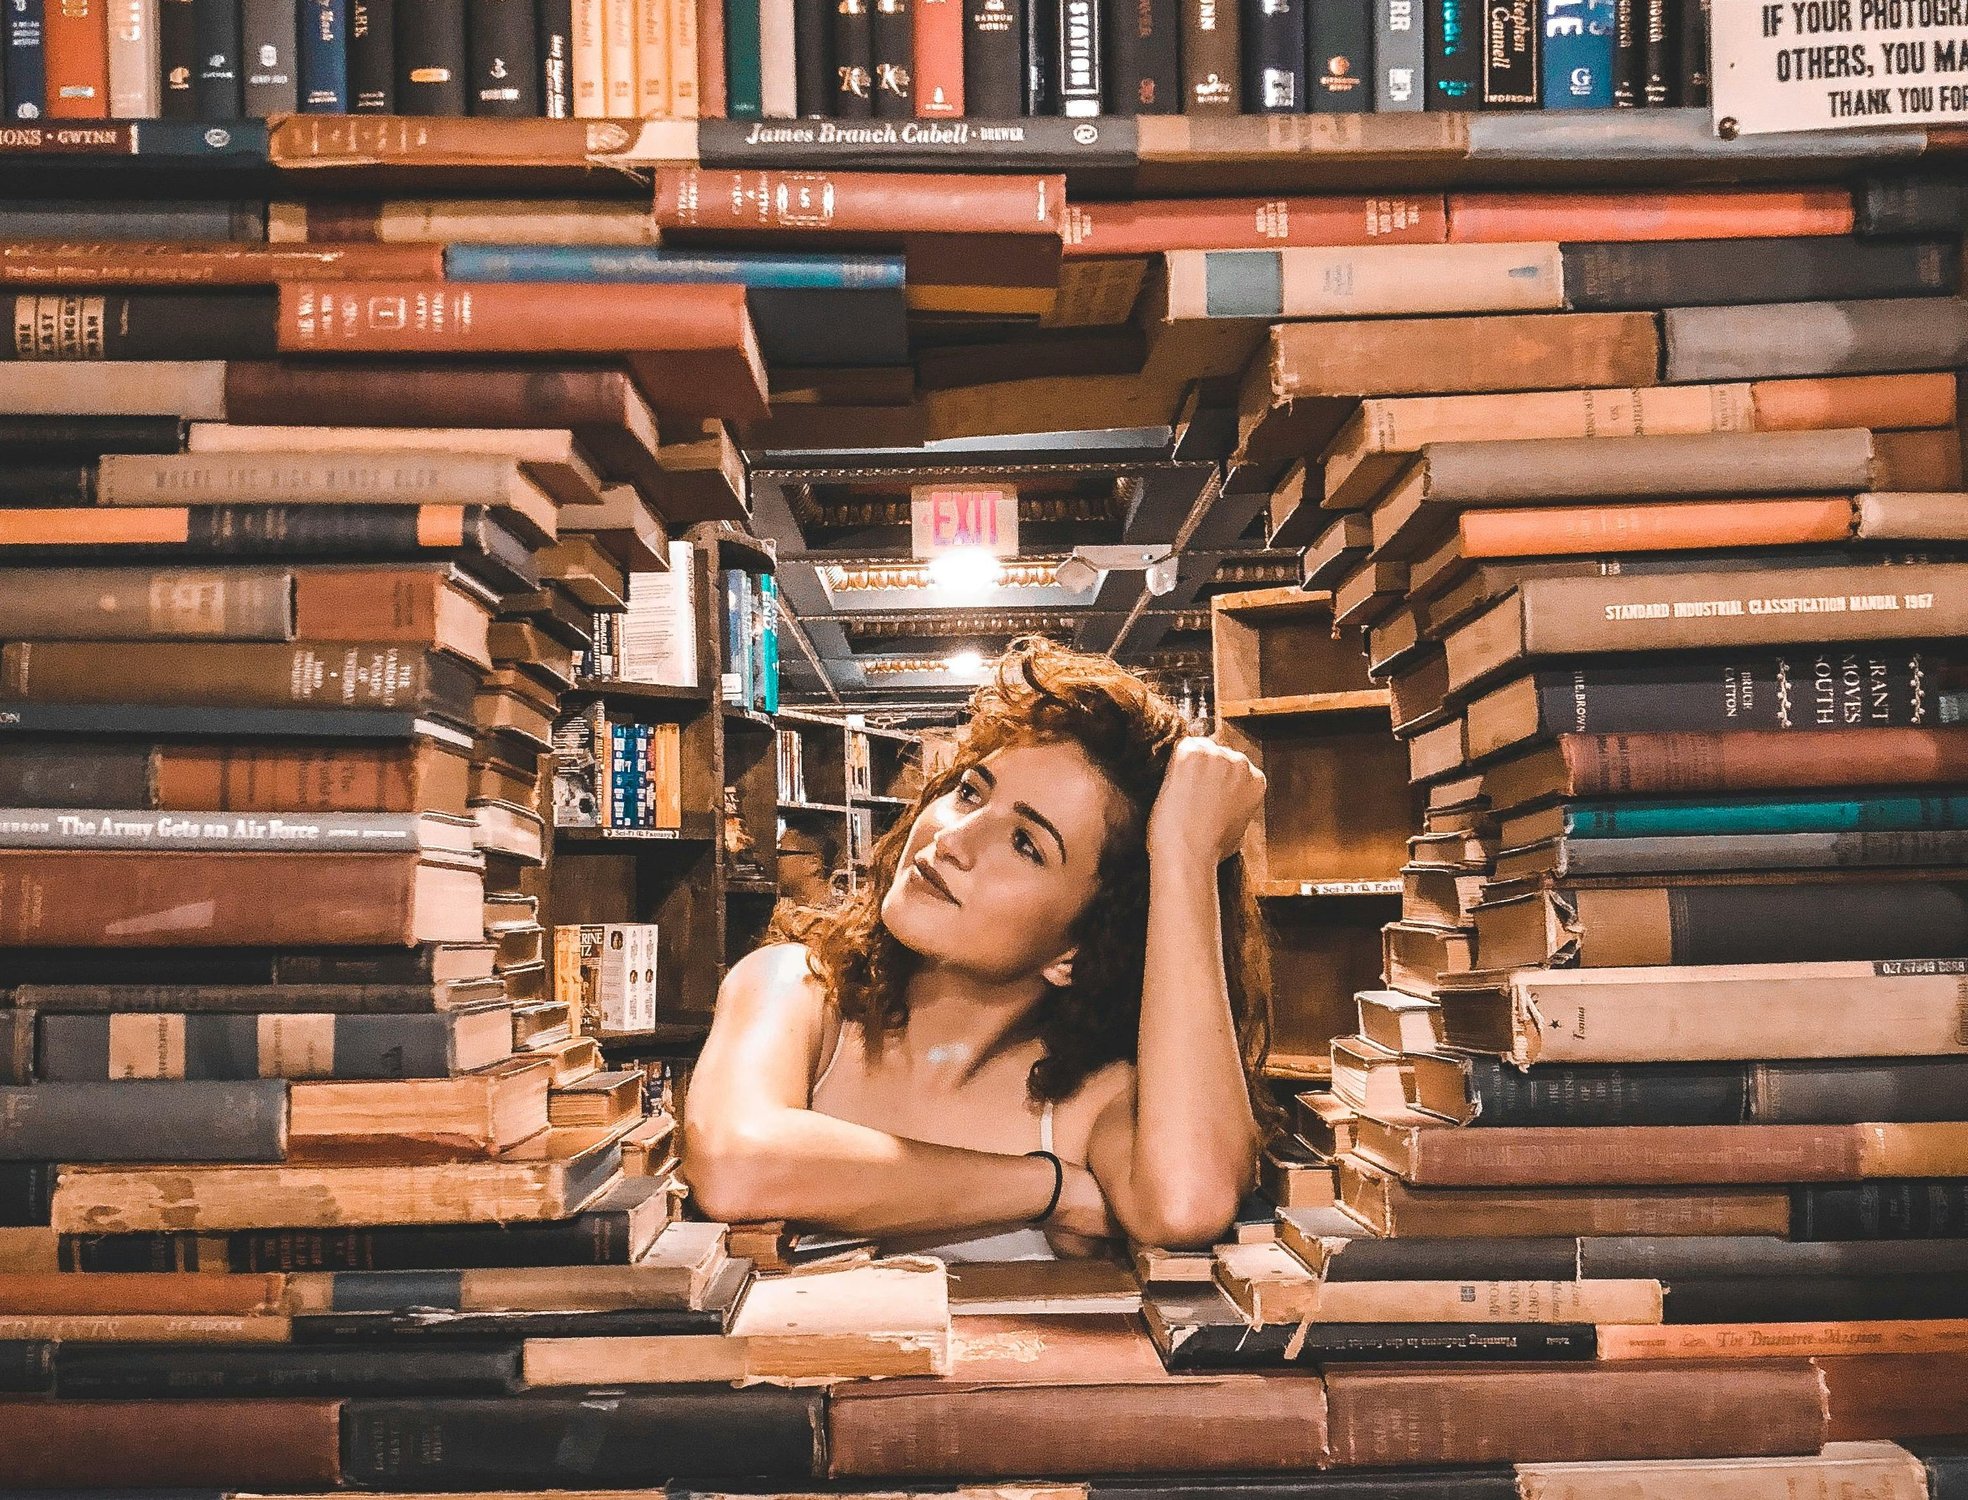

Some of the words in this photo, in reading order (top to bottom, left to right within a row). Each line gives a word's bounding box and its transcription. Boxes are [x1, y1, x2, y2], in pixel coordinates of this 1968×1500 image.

[353, 0, 369, 39] ARK
[1761, 4, 1784, 38] IF
[1792, 0, 1852, 36] YOUR
[1859, 0, 1968, 32] PHOTOGR
[1069, 2, 1089, 86] STATION
[1491, 7, 1511, 69] Cannell
[1776, 43, 1875, 82] OTHERS,
[1880, 41, 1926, 75] YOU
[1828, 88, 1892, 117] THANK
[1897, 86, 1935, 113] YOU
[744, 123, 813, 145] James
[818, 122, 897, 144] Branch
[901, 122, 969, 145] Cabell
[980, 127, 1025, 142] BREWER
[932, 491, 1003, 546] EXIT
[1604, 604, 1670, 621] STANDARD
[1674, 600, 1745, 618] INDUSTRIAL
[1749, 597, 1847, 616] CLASSIFICATION
[1850, 595, 1900, 612] MANUAL
[1904, 593, 1935, 610] 1967
[1814, 655, 1835, 724] OUTH
[57, 815, 96, 837] The
[100, 816, 155, 842] Army
[158, 817, 200, 839] Gets
[204, 823, 229, 838] an
[234, 819, 267, 839] Air
[269, 819, 321, 840] Force
[1322, 885, 1355, 894] Sci-Fi
[1571, 1006, 1586, 1041] Tomus
[1468, 1333, 1518, 1348] Planning
